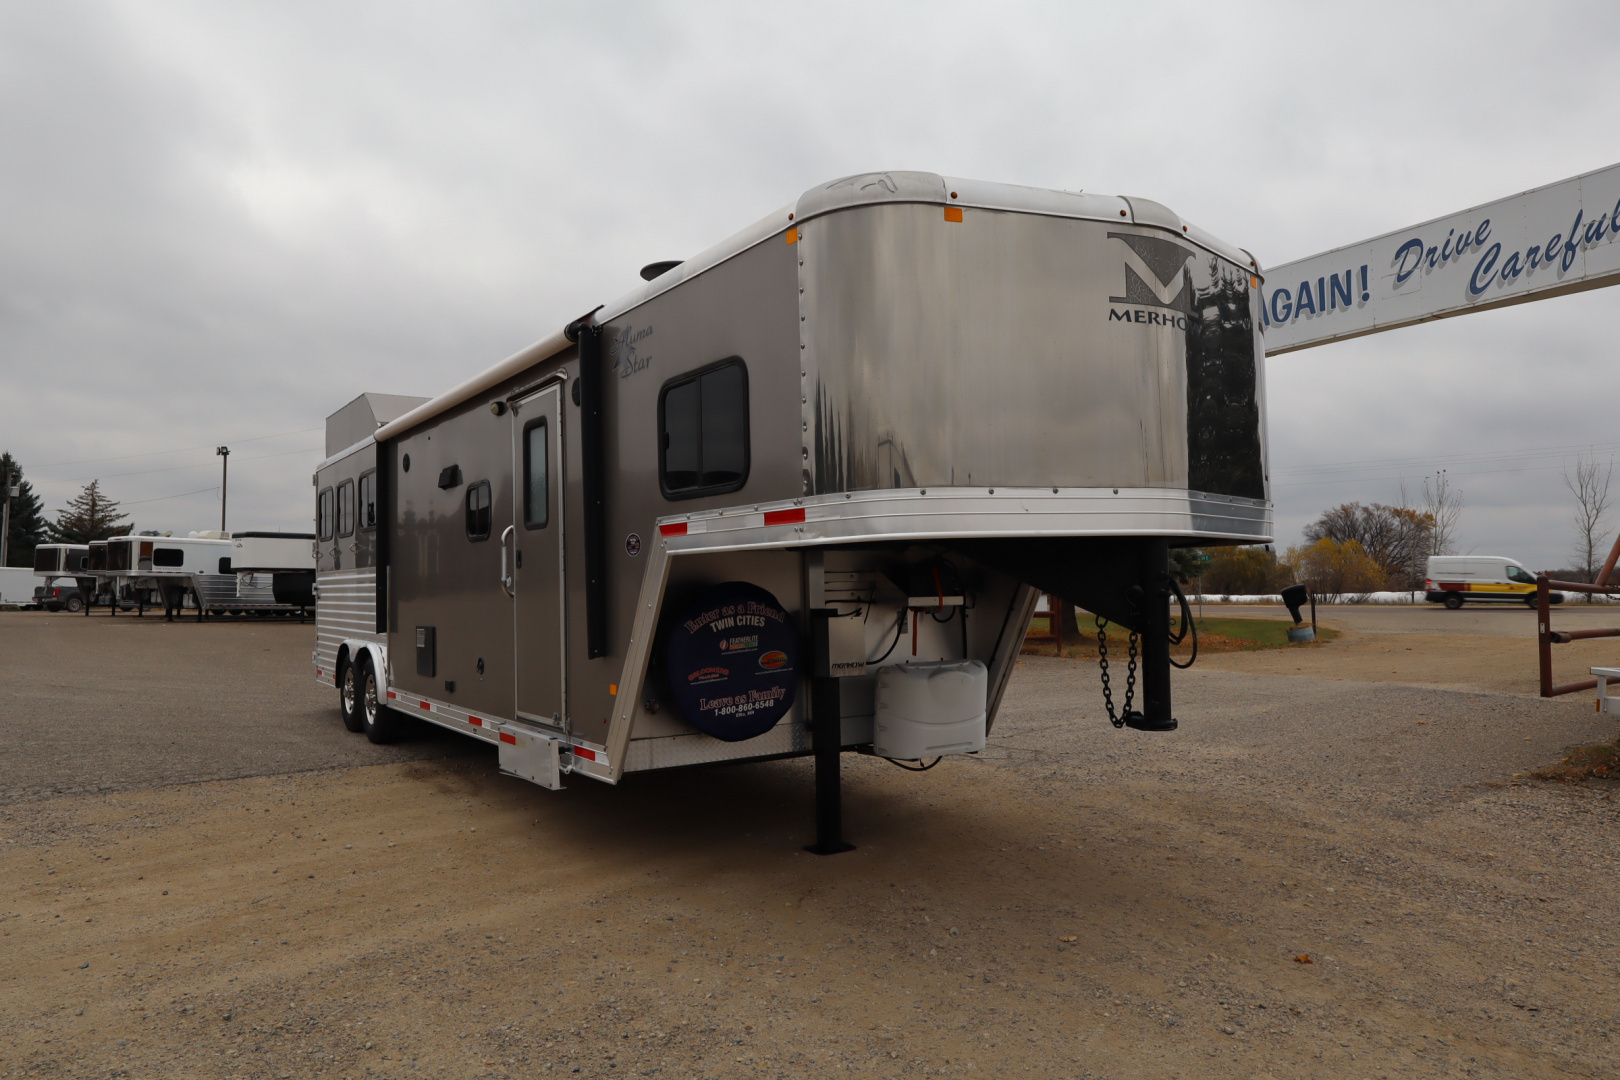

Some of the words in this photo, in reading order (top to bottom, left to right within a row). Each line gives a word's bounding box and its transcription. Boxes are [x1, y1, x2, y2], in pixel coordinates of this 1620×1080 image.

[1394, 218, 1491, 283] Drive
[620, 350, 653, 378] Star
[683, 607, 720, 635] Enter
[721, 604, 736, 616] as
[737, 604, 746, 614] a
[747, 601, 786, 624] Friend
[709, 616, 735, 633] TWIN
[736, 615, 766, 627] CITIES
[699, 697, 734, 711] Leave
[734, 694, 747, 704] as
[748, 685, 786, 703] Family
[714, 699, 775, 717] 1-800-860-6548
